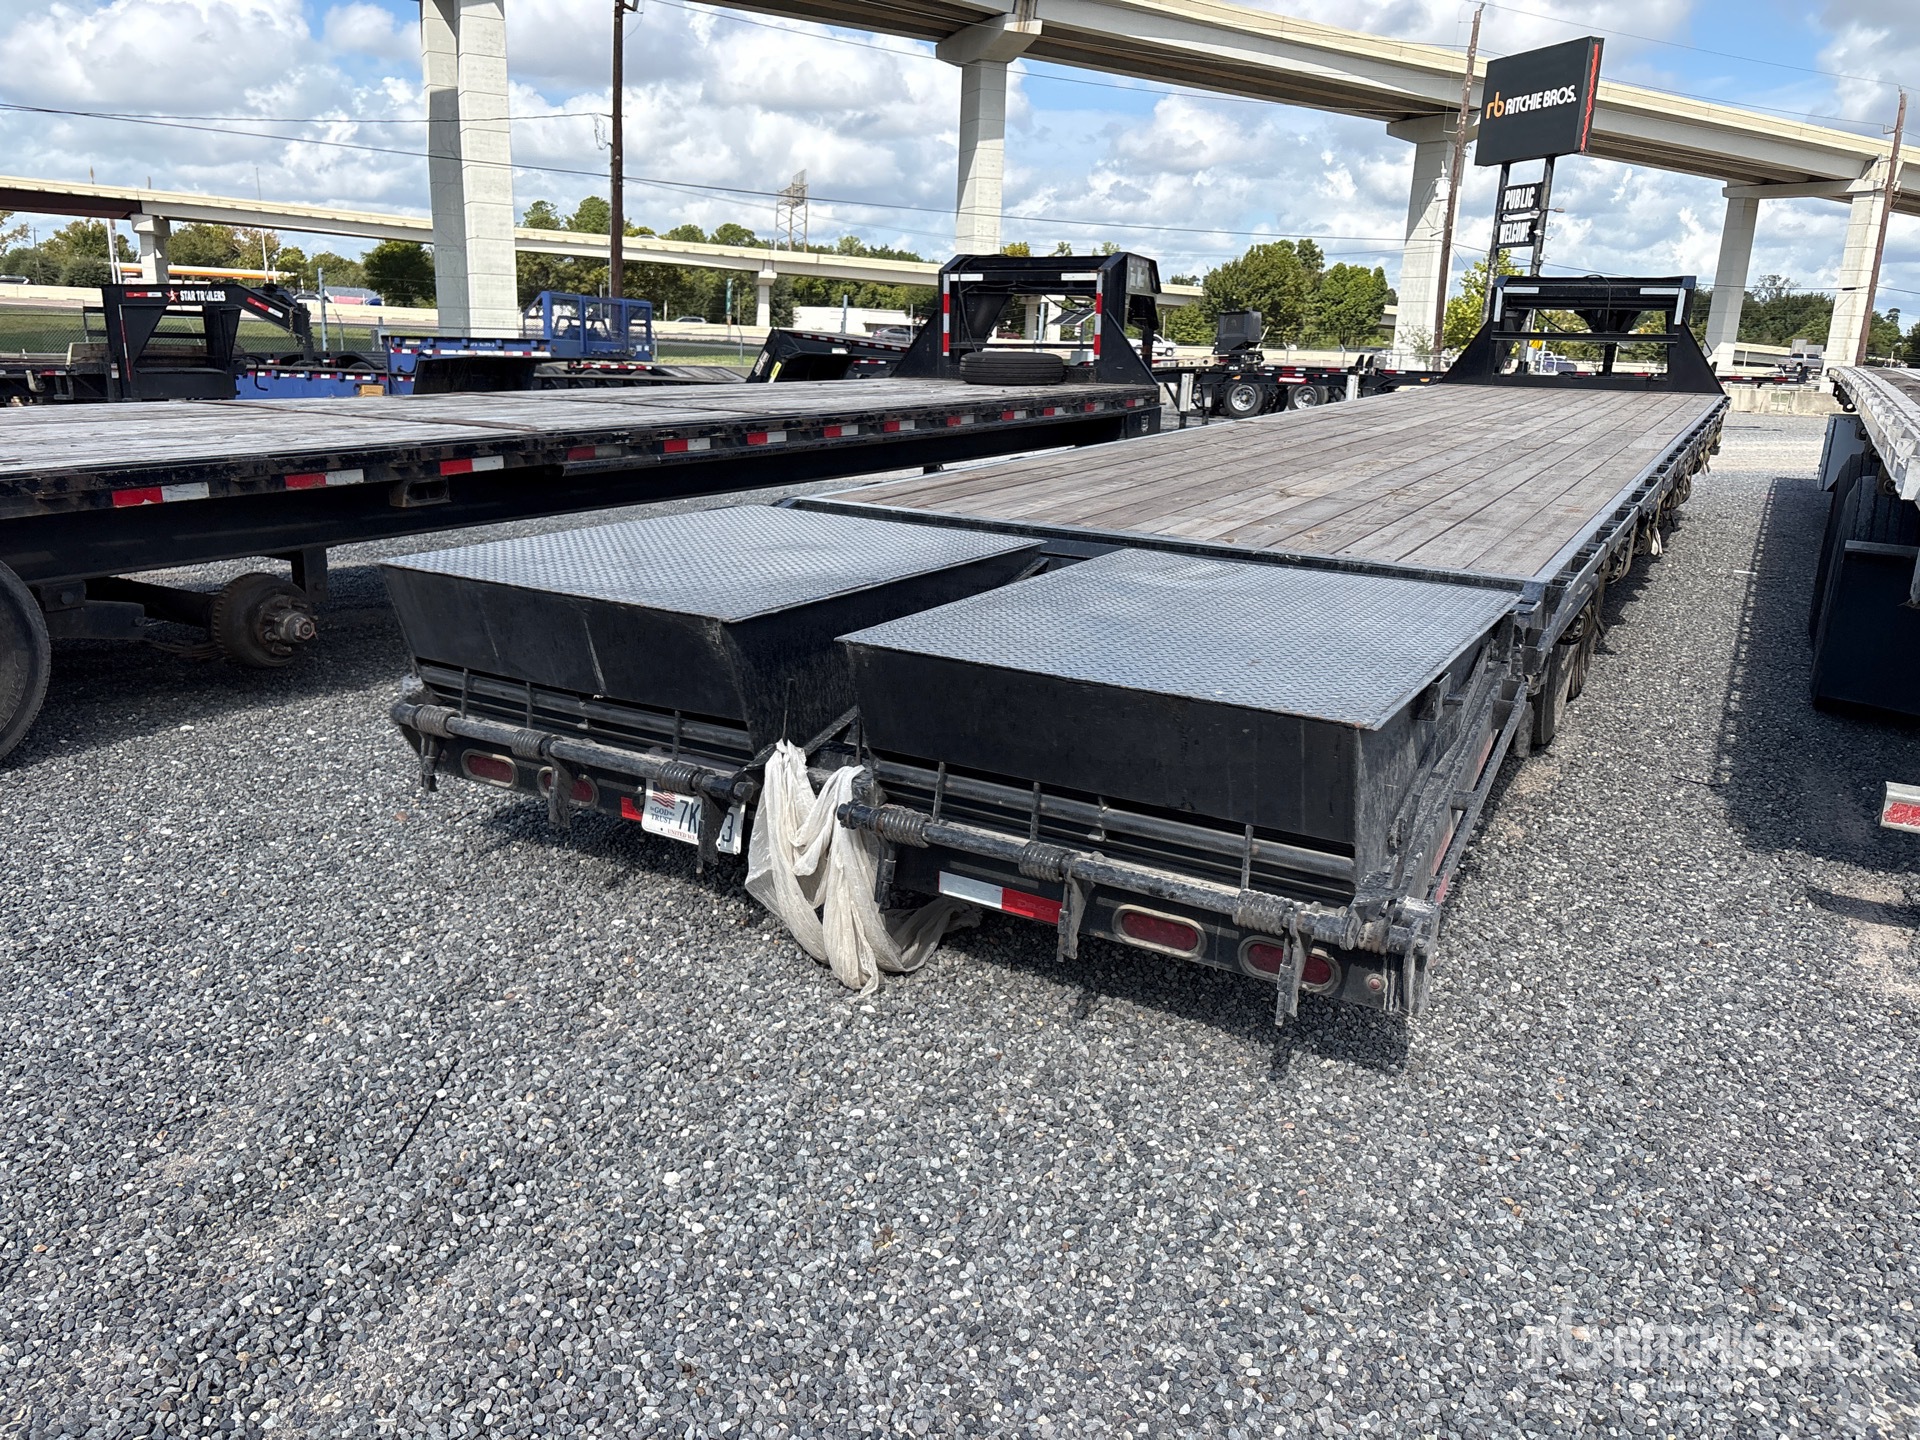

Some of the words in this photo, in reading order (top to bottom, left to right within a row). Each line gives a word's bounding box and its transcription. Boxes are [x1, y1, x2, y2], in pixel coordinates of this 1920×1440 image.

[1486, 92, 1504, 119] rb
[1505, 92, 1543, 115] RITCHIE
[1543, 85, 1576, 107] BROS.
[1503, 187, 1535, 210] PUBLIC
[1499, 222, 1531, 243] WELCOME
[180, 290, 196, 301] STAR
[655, 807, 669, 815] GOD
[651, 814, 672, 824] TRUST
[667, 828, 687, 838] UNITED
